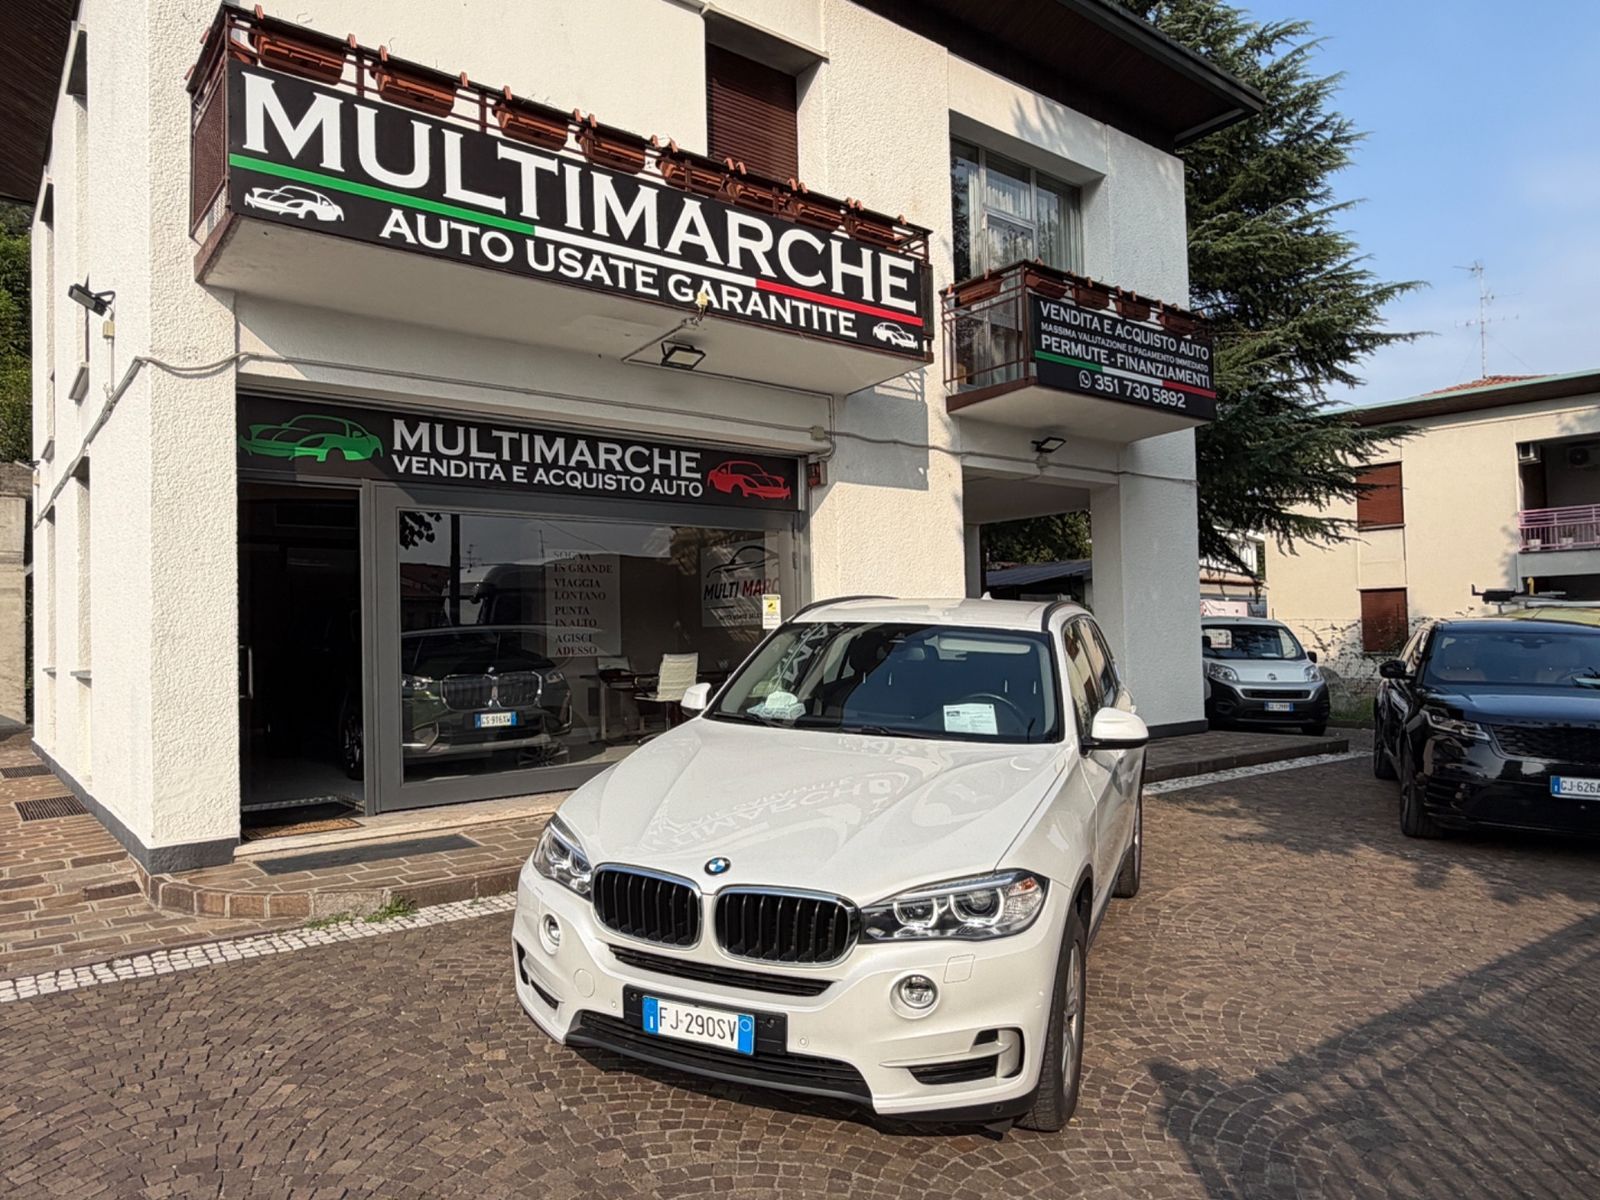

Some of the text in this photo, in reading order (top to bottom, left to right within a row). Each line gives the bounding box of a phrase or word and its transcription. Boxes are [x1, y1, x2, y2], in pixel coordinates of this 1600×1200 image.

[241, 71, 917, 312] MULTIMARCHE
[379, 208, 857, 338] AUTO USATE GARANTITE
[1040, 301, 1209, 360] VENDITA E ACQUISTO AUTO
[1041, 321, 1077, 339] MASSIMA
[1077, 332, 1127, 352] VALUTAZIONE
[1133, 346, 1175, 364] PAGAMENTO
[1041, 334, 1109, 364] PERMUTE
[1116, 353, 1210, 388] FINANZIAMENTI
[1094, 375, 1187, 409] 351 730 5892
[392, 418, 702, 479] MULTIMARCHE
[391, 454, 703, 498] VENDITA E ACQUISTO AUTO
[568, 563, 614, 575] GRANDE
[554, 578, 600, 588] VIAGGIA
[555, 591, 606, 601] LONTANO
[703, 580, 740, 601] MULTI
[555, 606, 590, 616] PUNTA
[570, 618, 597, 628] ALTO
[556, 633, 592, 643] AGISCI
[556, 646, 597, 656] ADESSO
